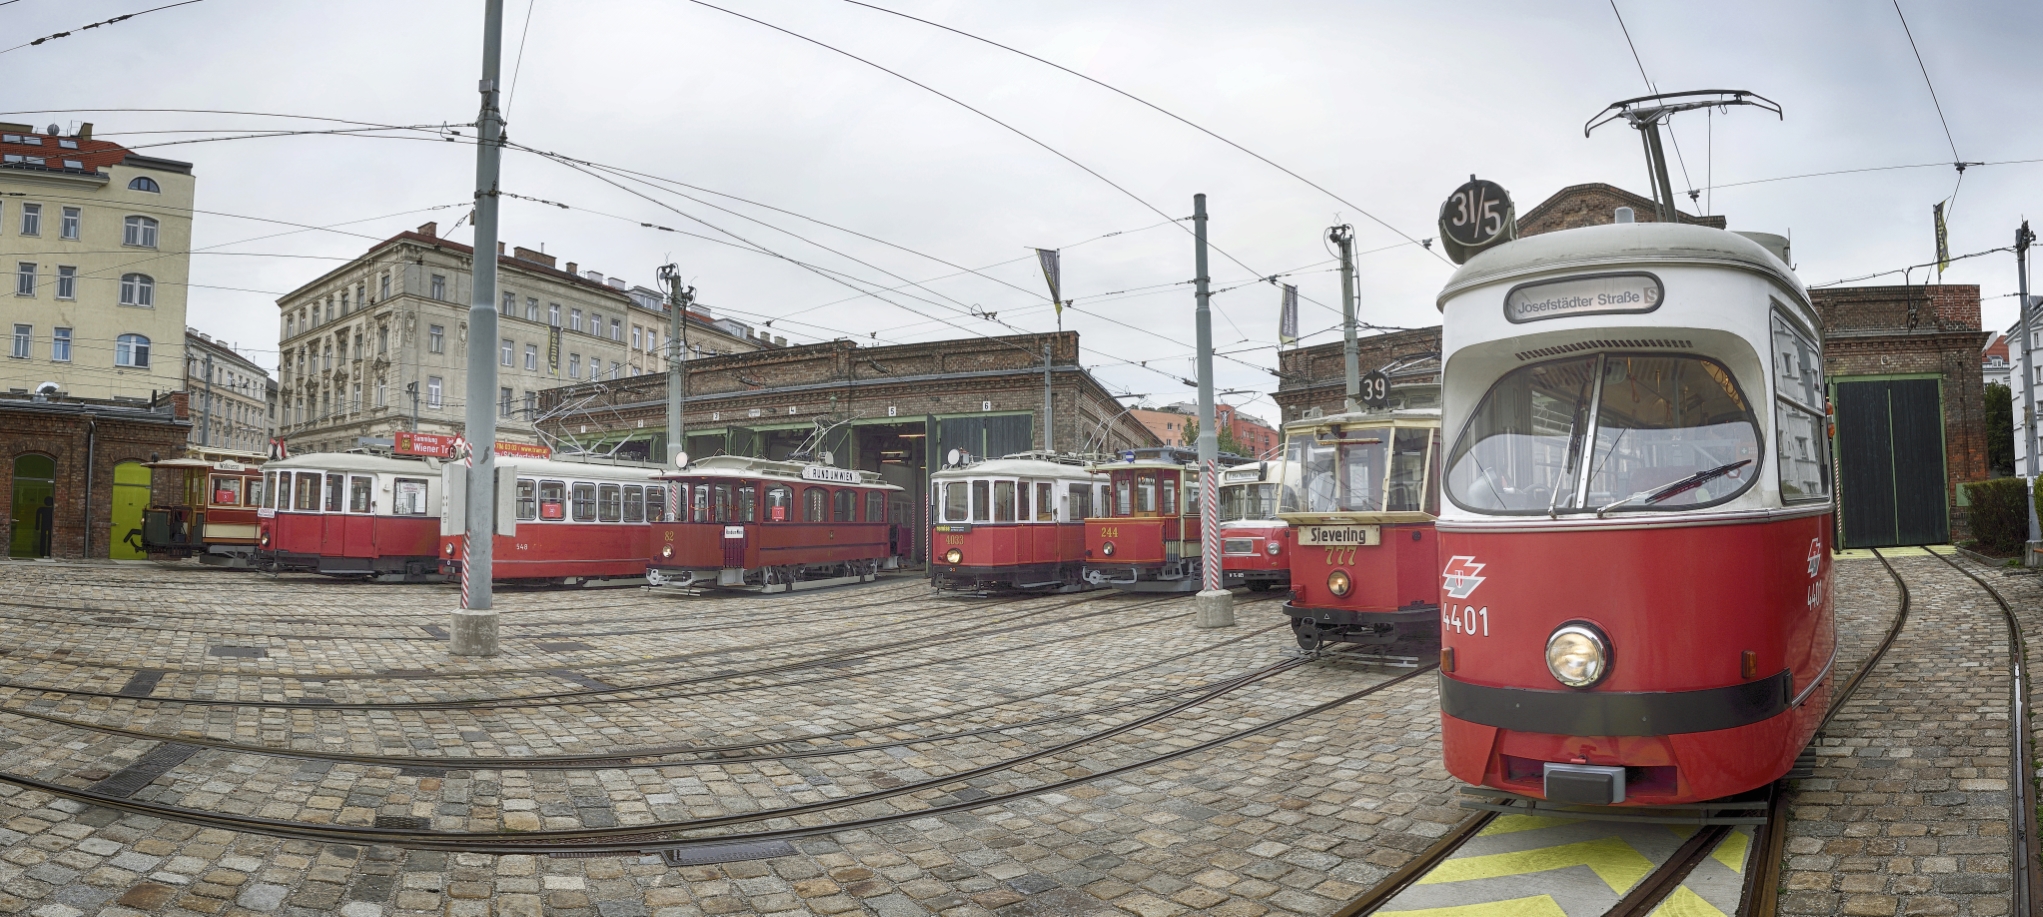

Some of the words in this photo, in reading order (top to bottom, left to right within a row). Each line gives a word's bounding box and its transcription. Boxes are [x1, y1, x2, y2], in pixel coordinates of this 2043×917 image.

[1450, 186, 1501, 239] 31/5
[1518, 297, 1594, 315] Josefstädter
[1597, 291, 1640, 306] Straße
[1363, 377, 1386, 400] 39
[413, 435, 438, 445] Sammlung
[413, 443, 440, 454] Wiener
[812, 468, 829, 480] RUND
[830, 470, 839, 480] UM
[839, 471, 853, 481] WIEN
[664, 530, 674, 541] 82
[945, 534, 964, 545] 4033
[1101, 526, 1118, 538] 244
[1311, 527, 1366, 545] Sievering
[1324, 545, 1357, 566] 777
[1442, 602, 1489, 637] 4401
